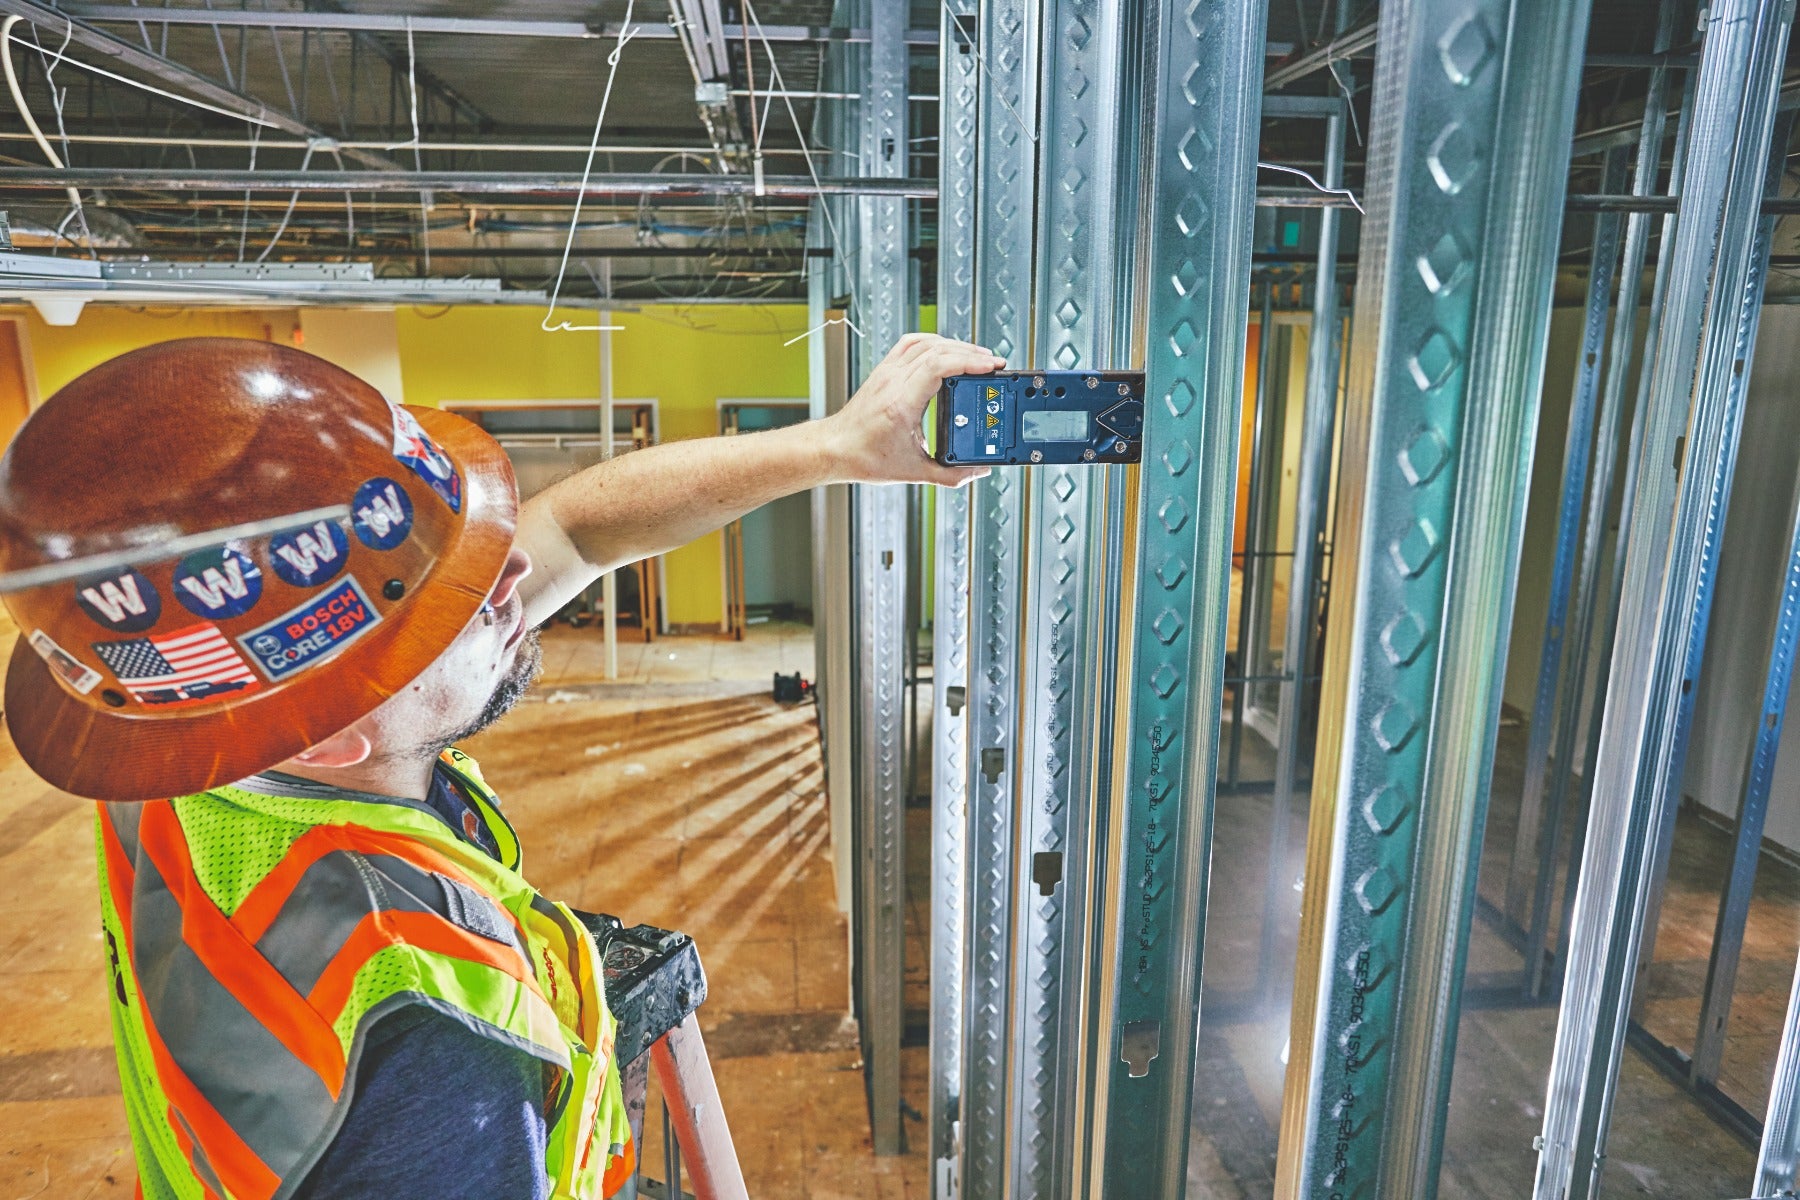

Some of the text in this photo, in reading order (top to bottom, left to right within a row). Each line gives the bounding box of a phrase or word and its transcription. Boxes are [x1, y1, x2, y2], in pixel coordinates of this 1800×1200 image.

[278, 520, 338, 577] W
[82, 572, 147, 623] W
[181, 556, 250, 610] W
[286, 589, 359, 640] BOSCH
[1150, 725, 1162, 777] 90345350
[1148, 783, 1159, 812] 70KSI
[1141, 893, 1152, 935] ProSTUD
[1350, 951, 1370, 1024] 90345350
[1345, 1034, 1361, 1075] 70KSI
